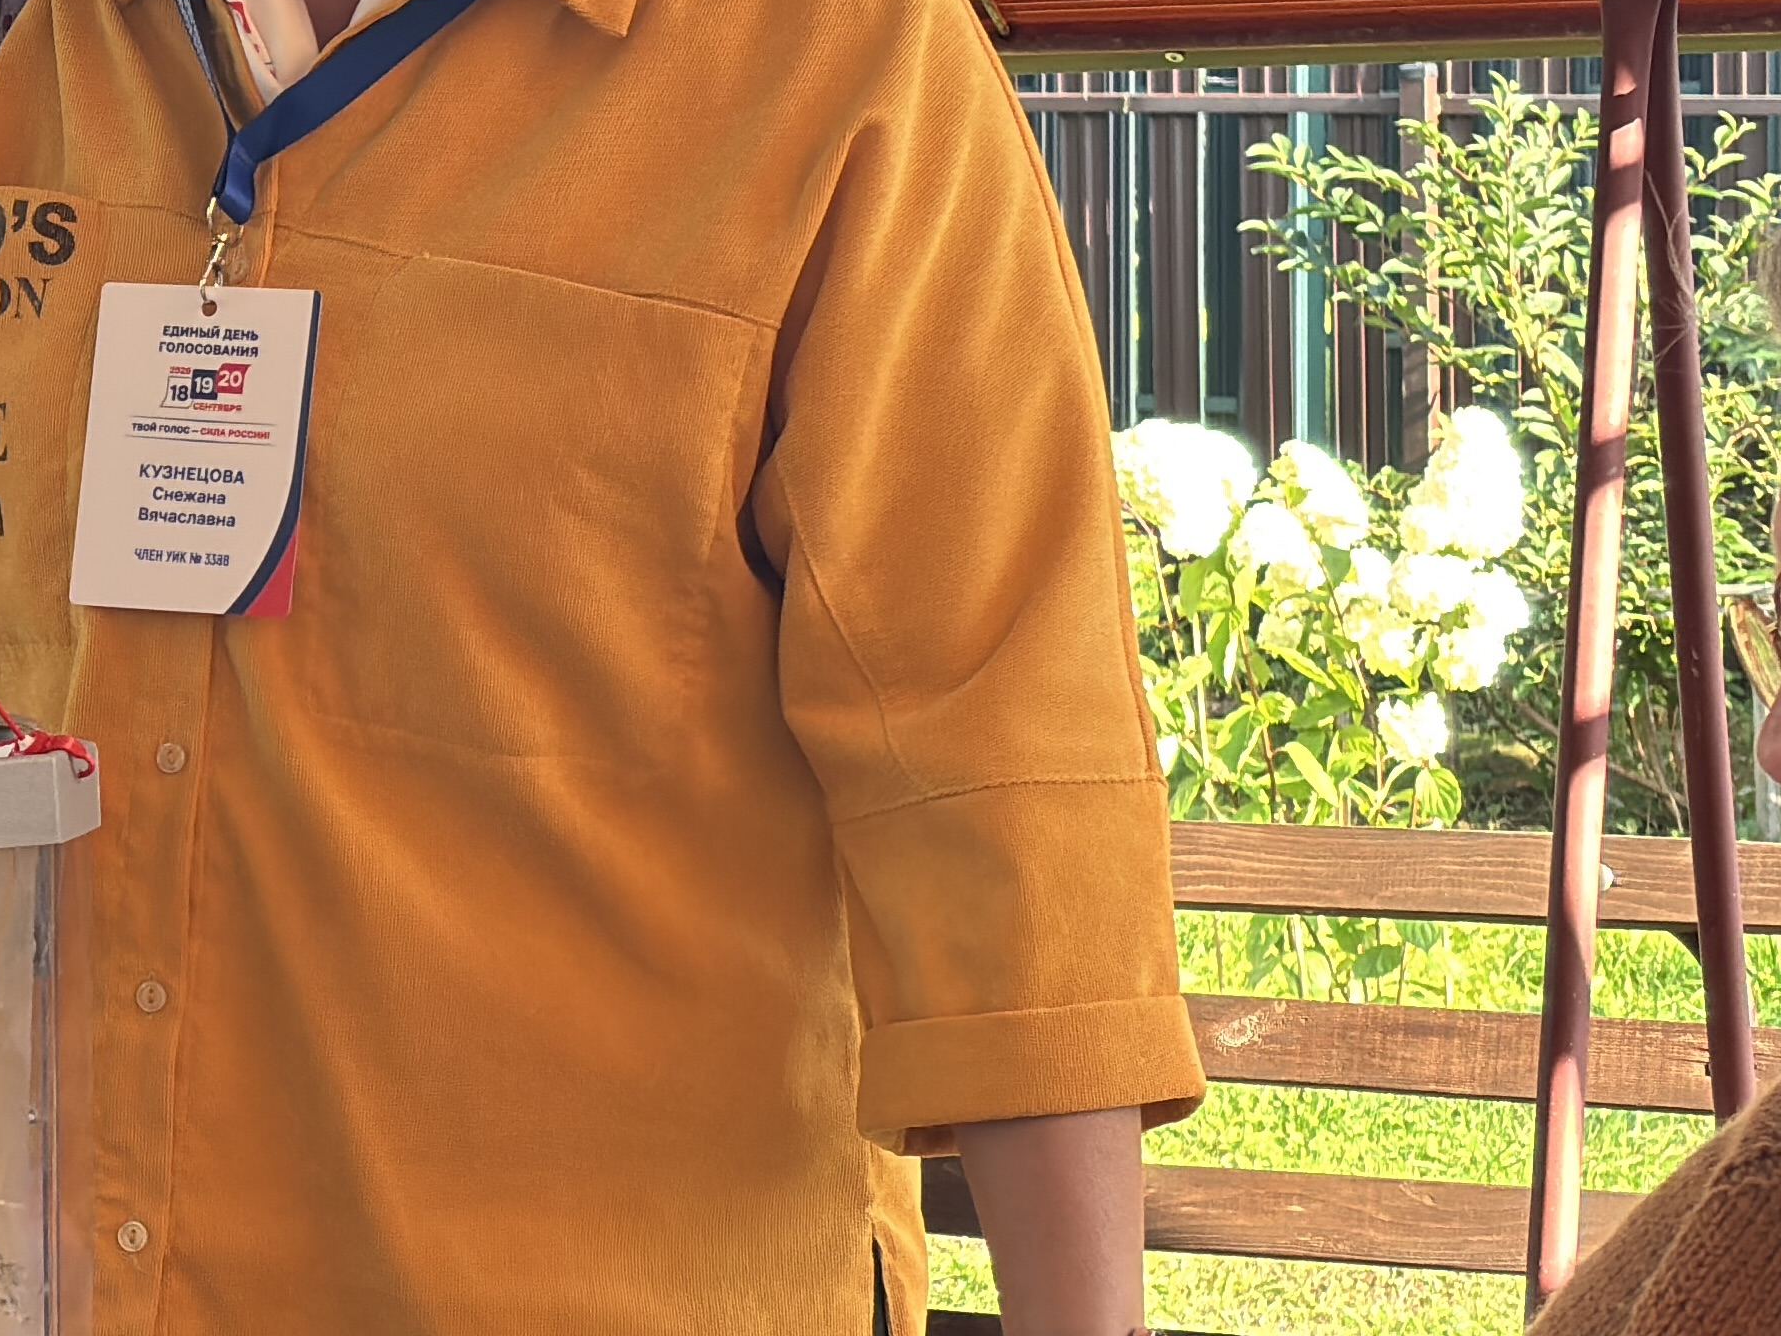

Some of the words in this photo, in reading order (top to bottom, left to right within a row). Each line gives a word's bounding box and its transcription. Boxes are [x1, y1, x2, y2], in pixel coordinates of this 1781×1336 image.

[162, 325, 220, 340] ЕДИНЫЙ
[222, 328, 259, 341] ДЕНЬ
[158, 341, 259, 358] ГОЛОСОВАНИЯ
[169, 384, 189, 402] 18
[194, 376, 213, 394] 19
[217, 370, 243, 388] 20
[132, 422, 157, 432] ТВОЙ
[158, 424, 190, 435] ГОЛОС
[200, 427, 226, 437] СИЛА
[139, 463, 245, 485] КУЗНЕЦОВА
[152, 486, 227, 505] Снежана
[134, 548, 163, 562] ЧЛЕН
[166, 550, 186, 564] УИК
